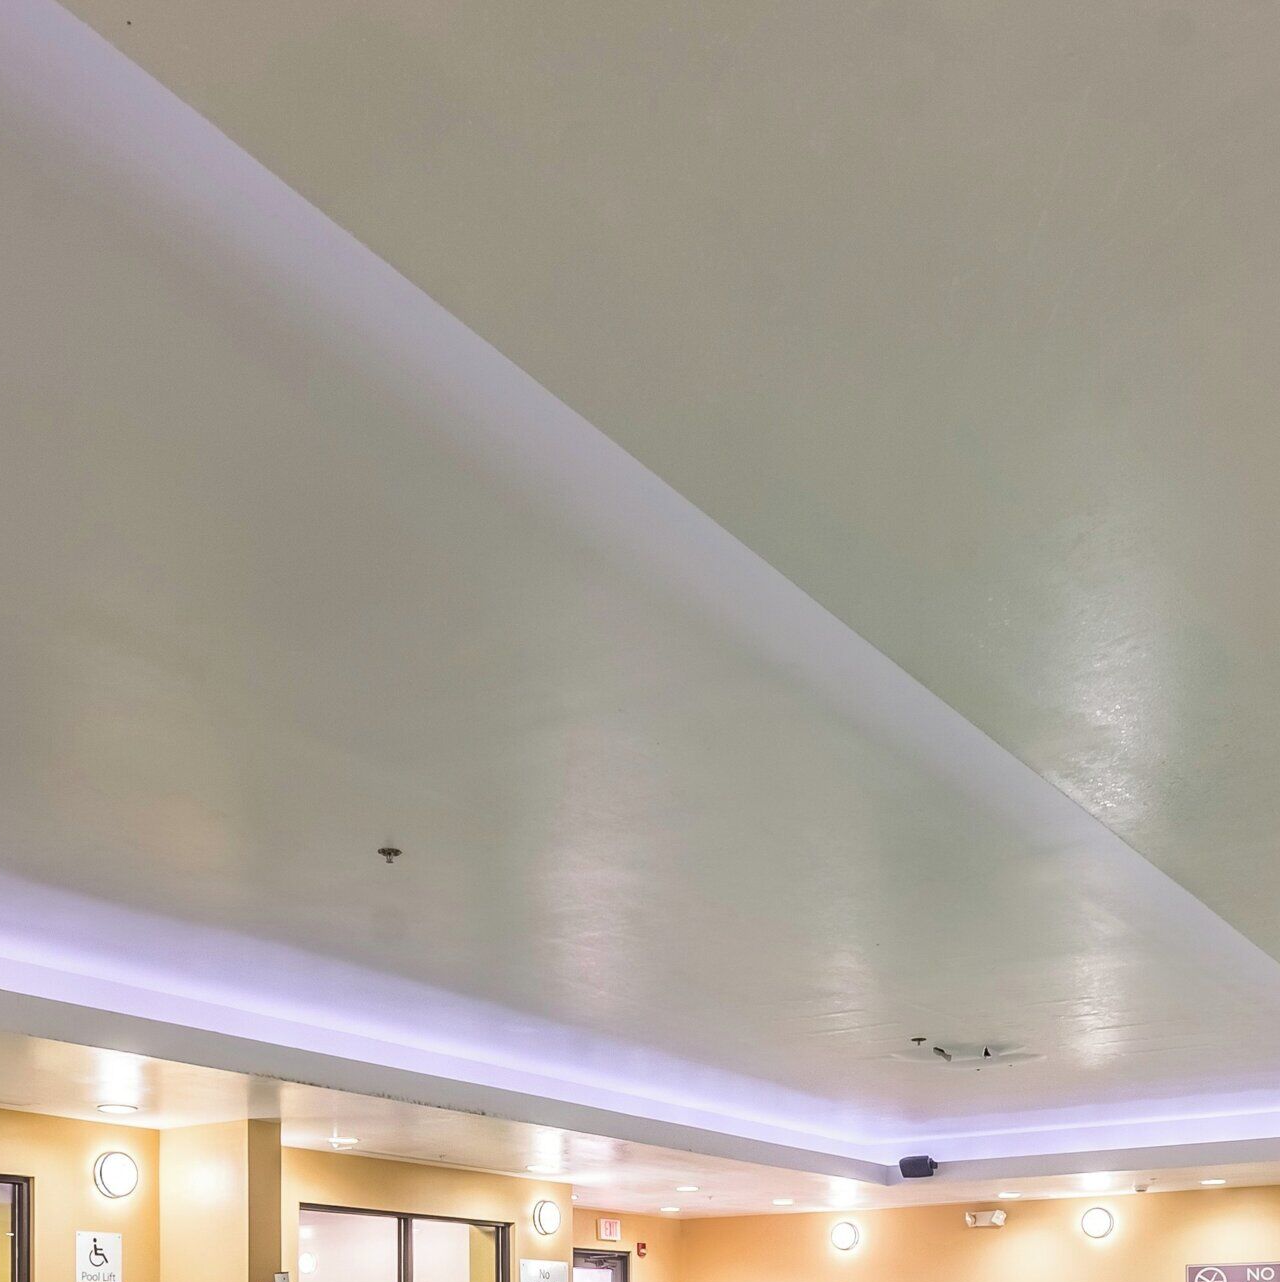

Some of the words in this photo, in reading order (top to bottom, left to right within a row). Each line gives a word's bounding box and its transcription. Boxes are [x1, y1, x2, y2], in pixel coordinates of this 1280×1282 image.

[605, 1221, 617, 1237] EXIT
[81, 1271, 100, 1281] Pool
[102, 1272, 116, 1282] Lift
[539, 1269, 550, 1280] No
[1247, 1267, 1275, 1281] NO
